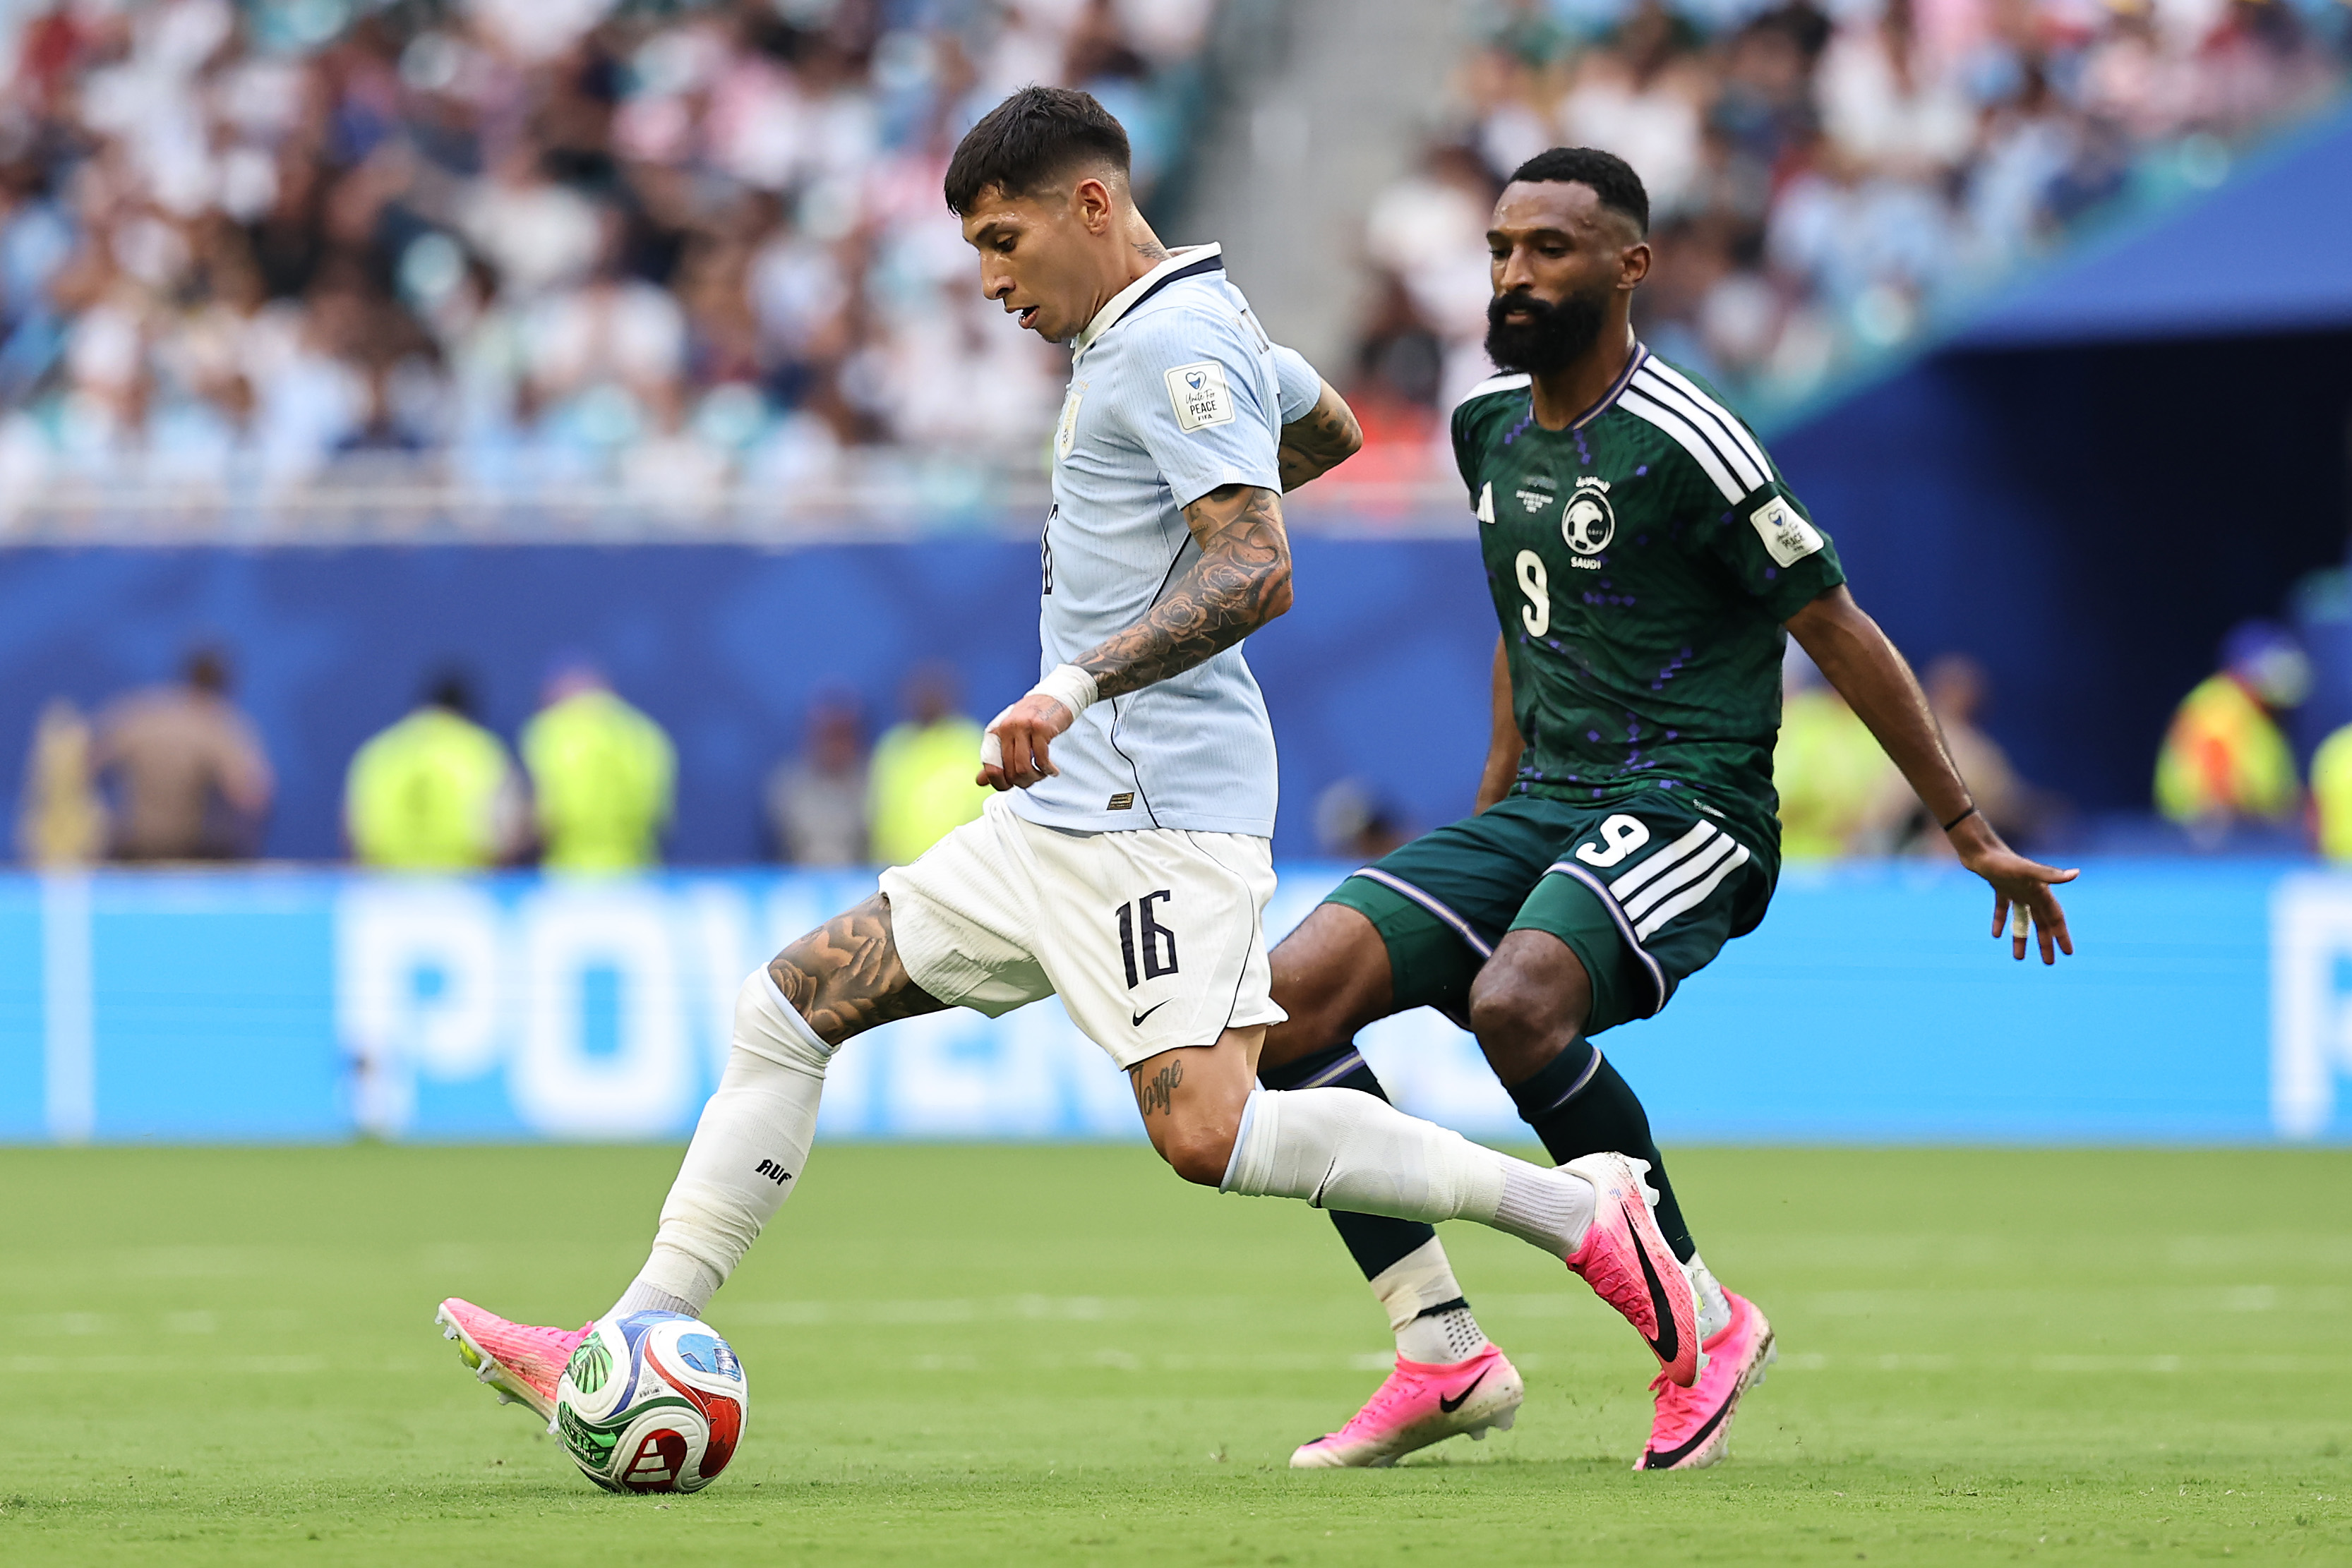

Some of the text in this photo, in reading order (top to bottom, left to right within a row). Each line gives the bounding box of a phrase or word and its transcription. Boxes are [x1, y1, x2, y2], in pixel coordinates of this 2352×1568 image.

[1189, 399, 1218, 416] PEACE
[1571, 556, 1602, 570] SAUDI
[1515, 548, 1551, 638] 9
[1575, 814, 1650, 868] 9
[1115, 889, 1180, 991] 16
[755, 1159, 793, 1186] AUF
